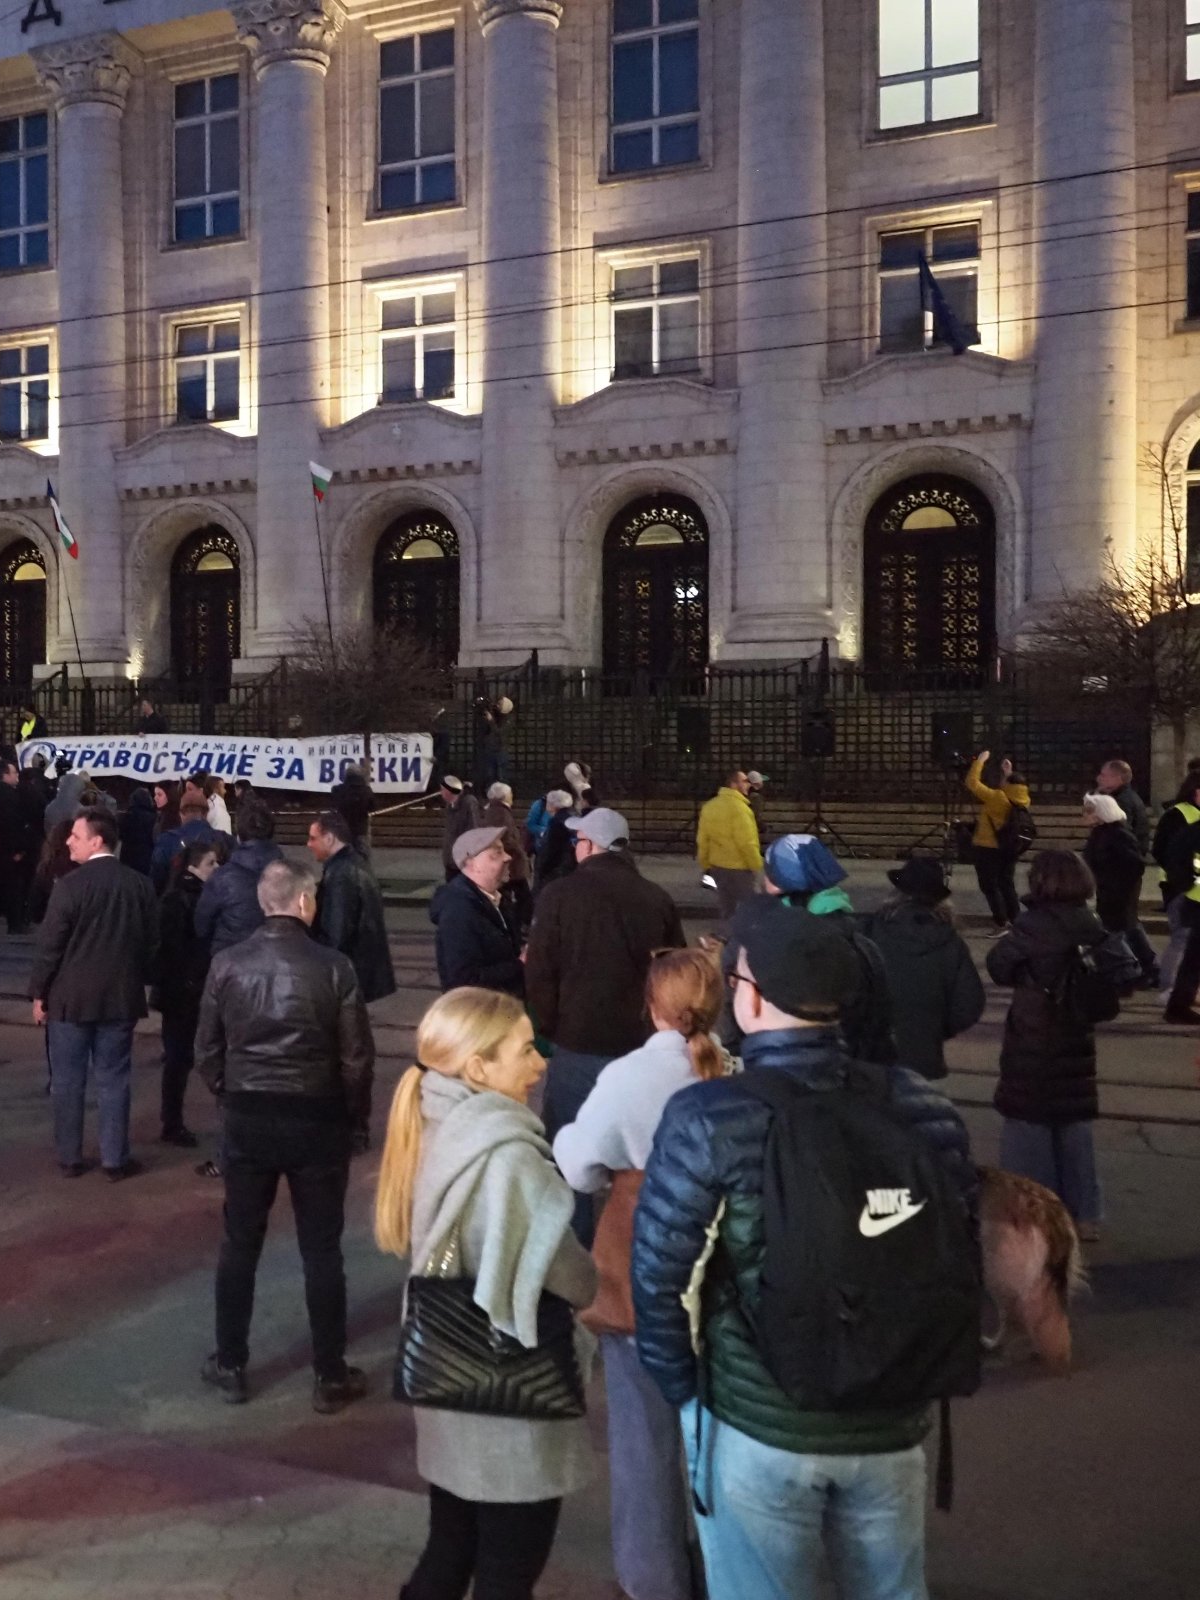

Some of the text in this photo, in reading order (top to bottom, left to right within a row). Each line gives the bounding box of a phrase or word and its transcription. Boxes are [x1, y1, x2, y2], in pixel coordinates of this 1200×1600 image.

[64, 741, 421, 755] НАЦИОНАЛНА ГРАЖДАНСКА ИНИЦИТИВА
[266, 757, 305, 780] ЗА
[866, 1188, 912, 1214] NIKE
